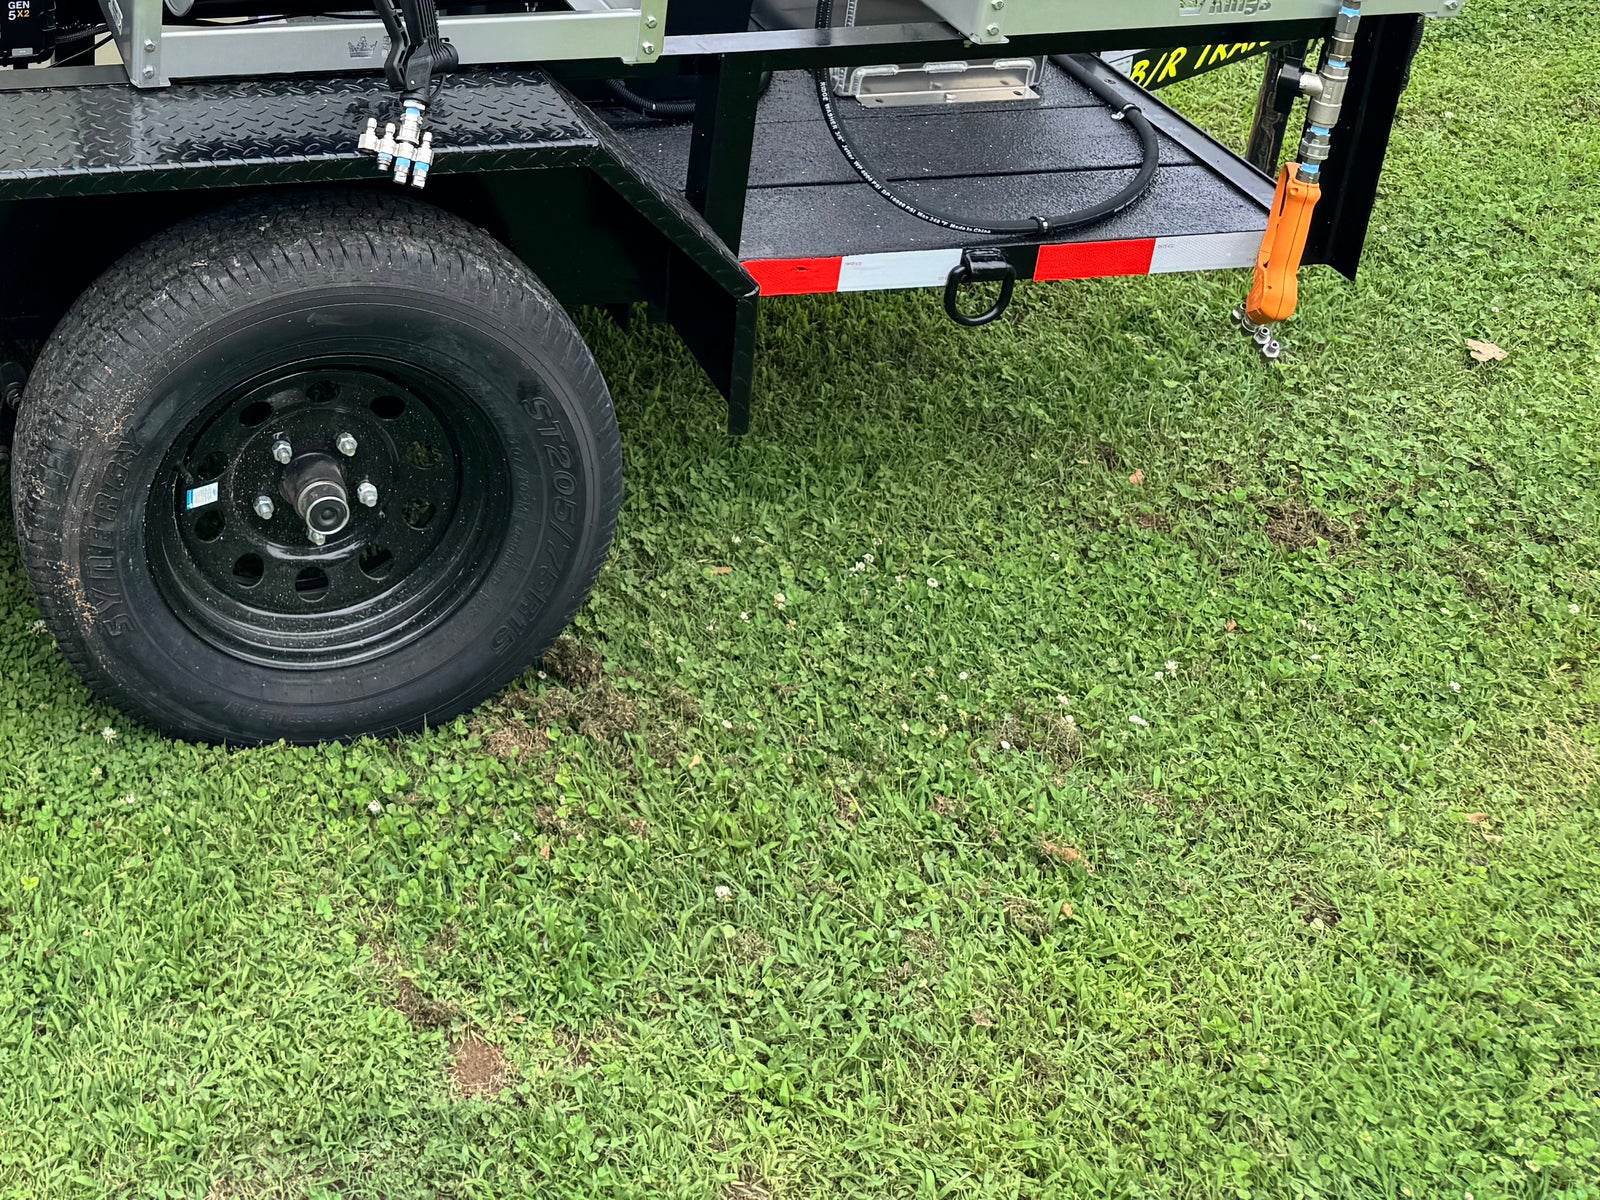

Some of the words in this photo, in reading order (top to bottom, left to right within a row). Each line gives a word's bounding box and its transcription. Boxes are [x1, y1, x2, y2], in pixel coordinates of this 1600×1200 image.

[8, 0, 30, 10] GEN
[1129, 46, 1188, 89] B/R
[853, 160, 863, 171] WP
[871, 179, 882, 190] PSI
[905, 205, 916, 214] PSI
[949, 223, 966, 231] Made
[973, 227, 991, 235] China
[87, 426, 143, 637] SYNERGY
